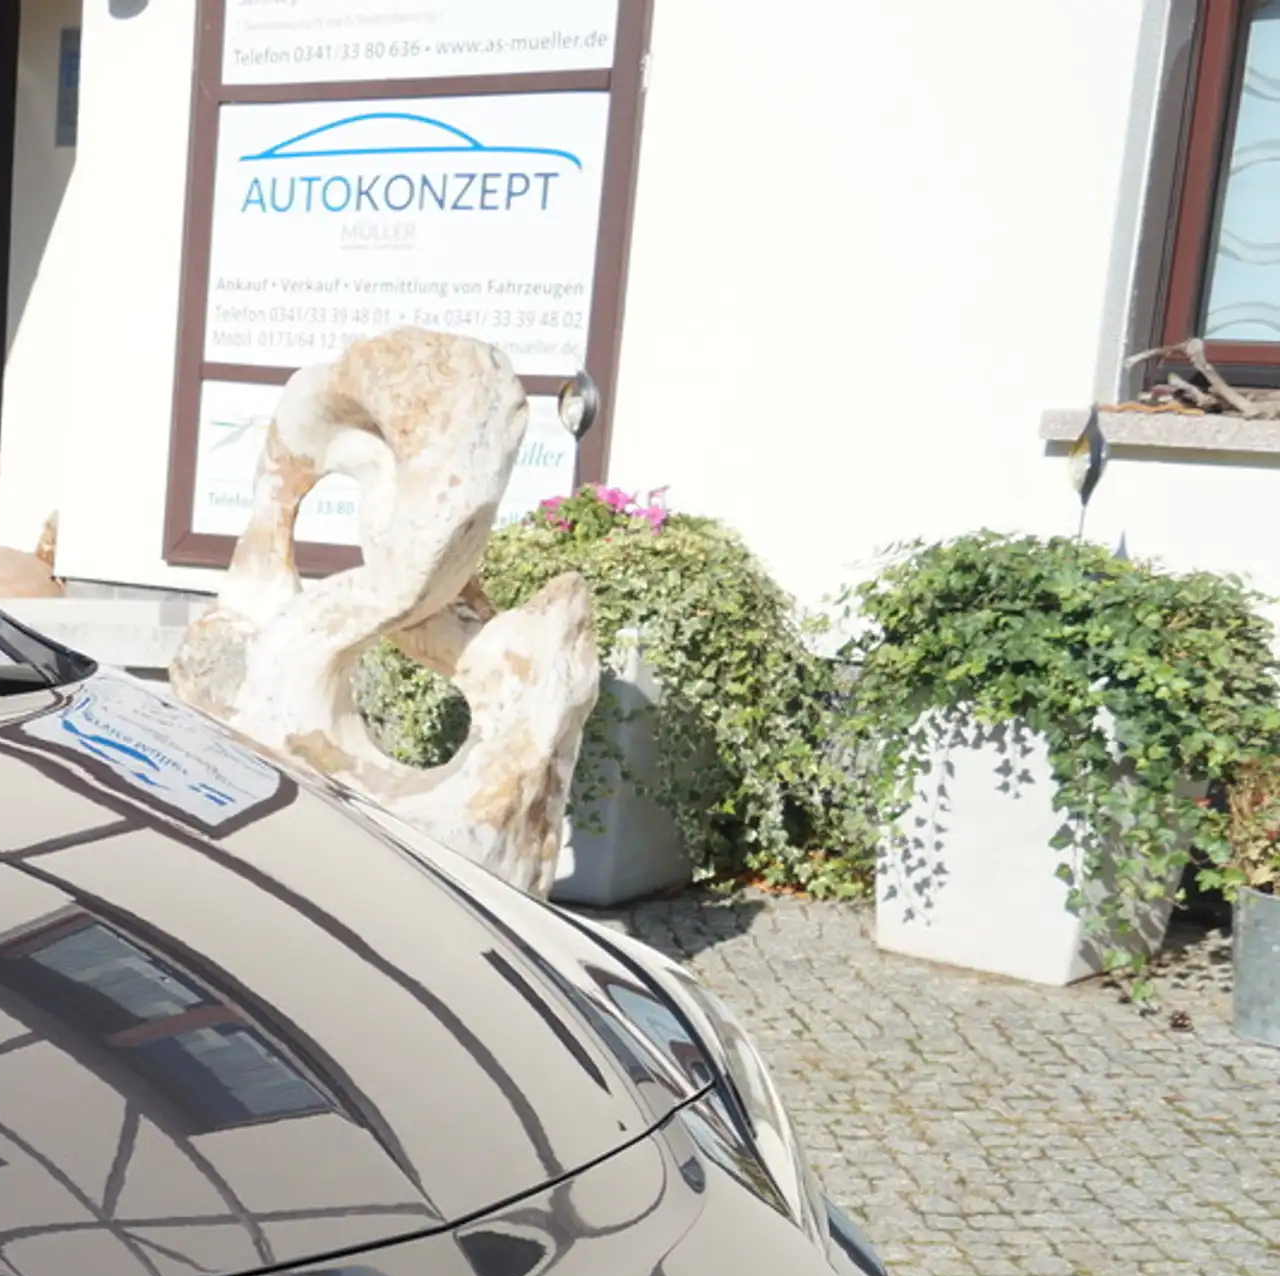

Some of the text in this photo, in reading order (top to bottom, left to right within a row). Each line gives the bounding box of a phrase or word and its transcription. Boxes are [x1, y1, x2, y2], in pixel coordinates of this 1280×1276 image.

[234, 46, 289, 66] Telefon
[365, 41, 385, 59] 80
[389, 39, 421, 57] 636
[435, 30, 608, 55] www.as-mueller.de
[241, 172, 560, 213] AUTOKONZEPT
[216, 277, 584, 300] Ankauf Verkauf Vermittlung von Fahrzeugen
[215, 304, 266, 323] Telefon
[351, 307, 370, 325] 48
[413, 307, 440, 325] Fax
[492, 309, 512, 327] 33
[516, 309, 536, 328] 39
[539, 310, 560, 328] 48
[562, 310, 584, 329] 02
